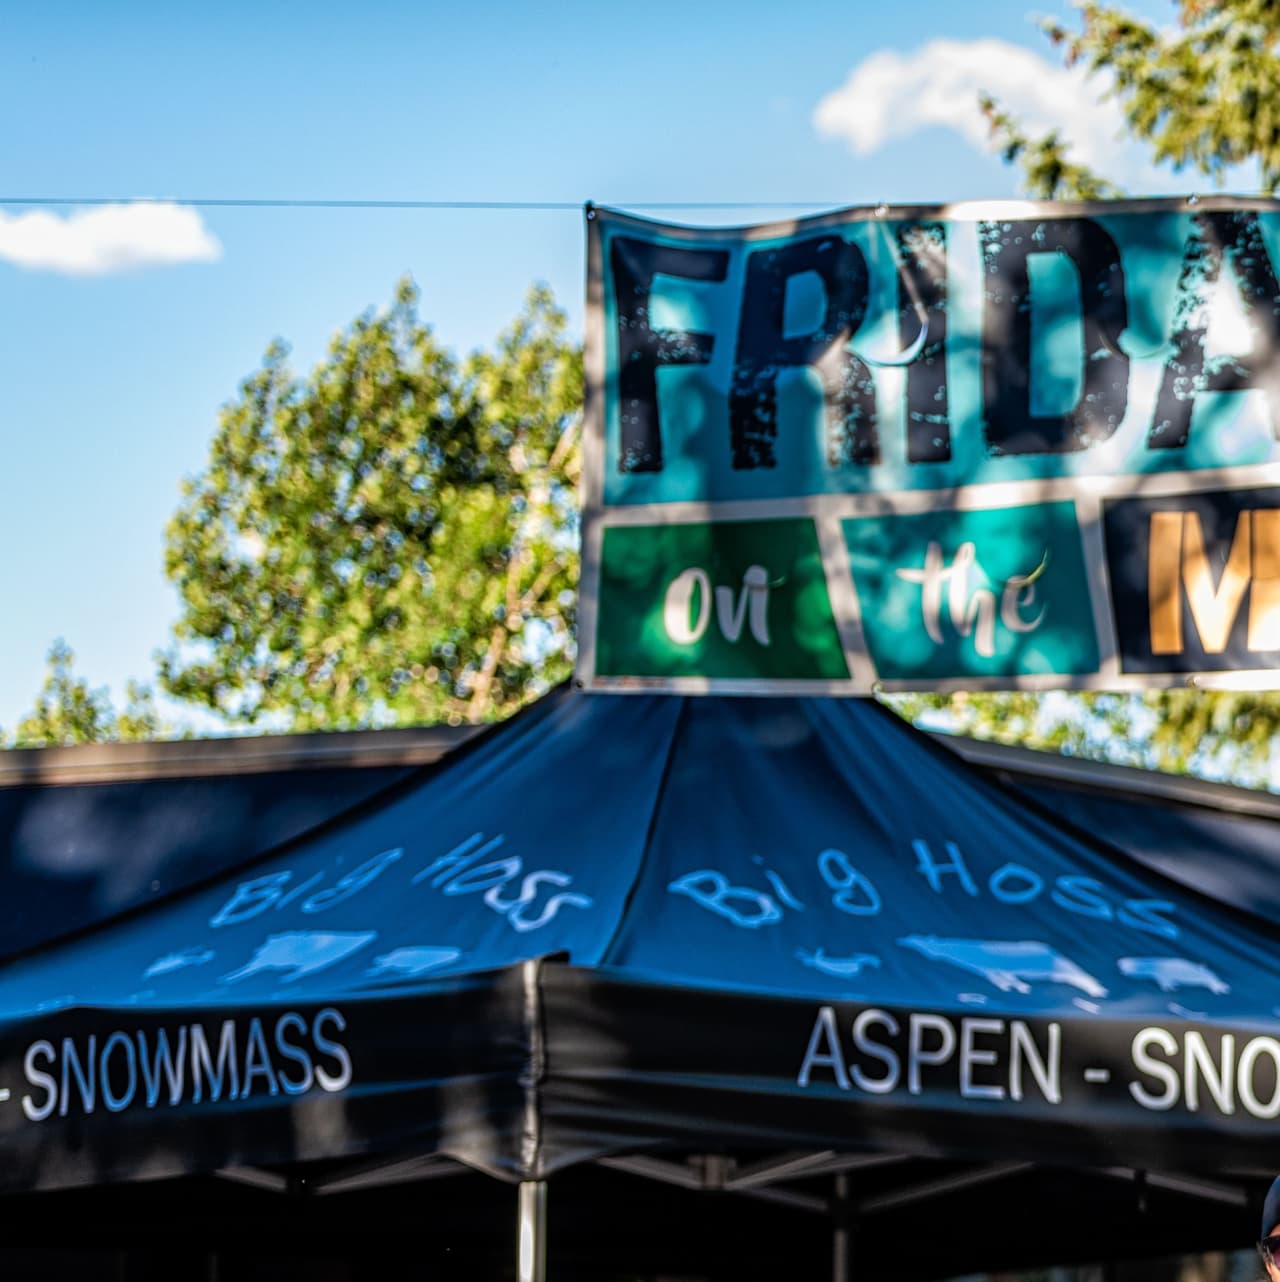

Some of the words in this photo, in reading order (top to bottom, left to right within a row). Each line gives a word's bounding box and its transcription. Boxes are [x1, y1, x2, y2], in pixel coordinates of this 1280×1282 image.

[897, 541, 1047, 658] the
[22, 1008, 354, 1122] SNOWMASS
[798, 1006, 1062, 1104] ASPEN
